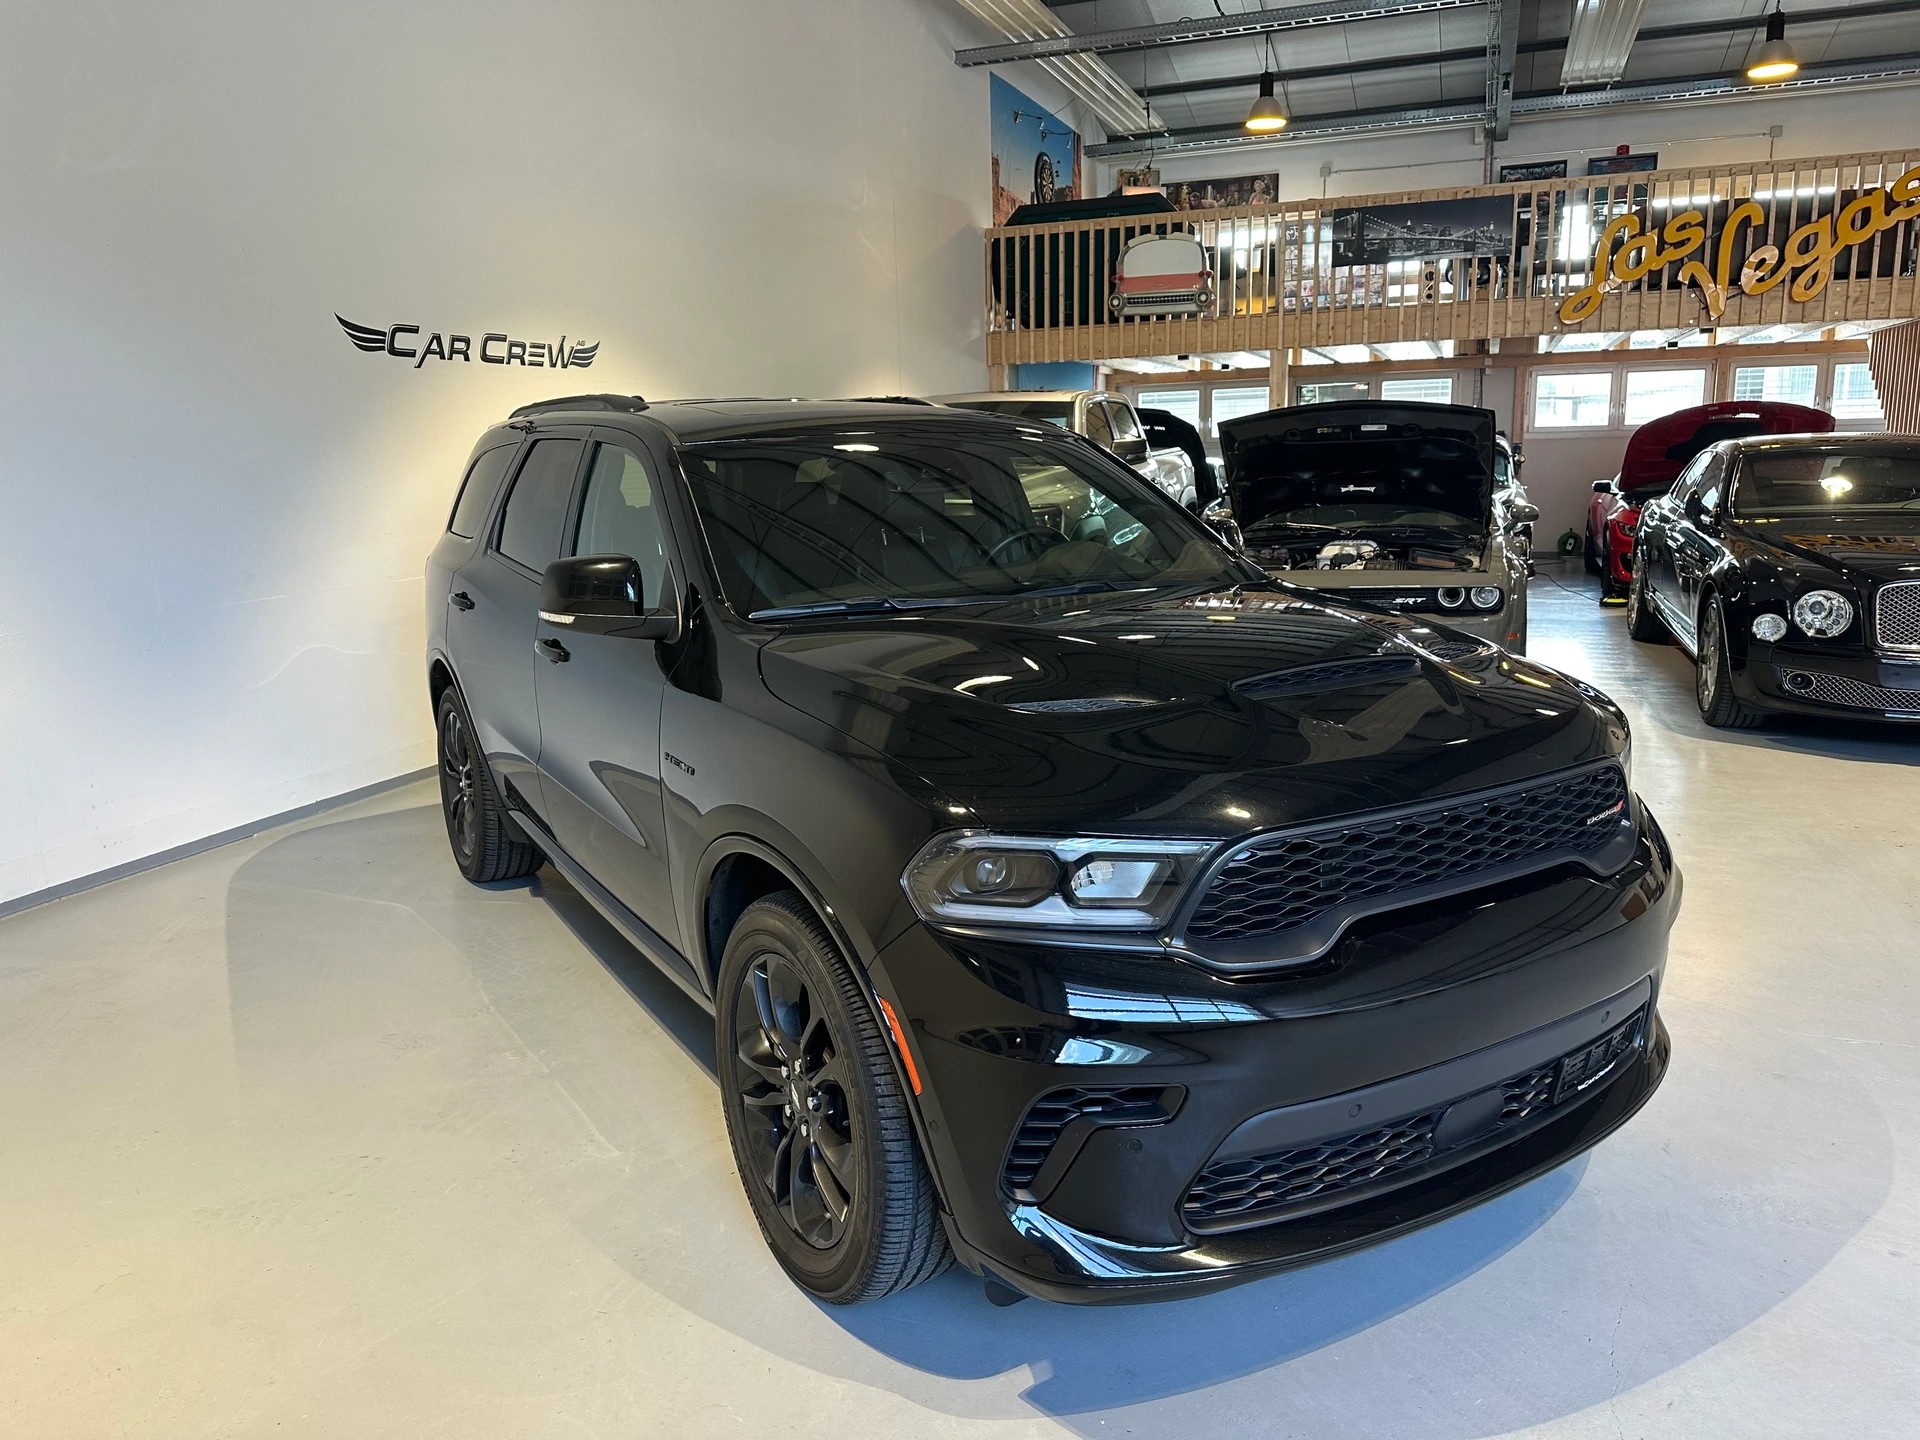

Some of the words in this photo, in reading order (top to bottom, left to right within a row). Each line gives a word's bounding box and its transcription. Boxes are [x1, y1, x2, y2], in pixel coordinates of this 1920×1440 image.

[1559, 209, 1706, 325] Las
[386, 323, 471, 369] CAR
[480, 332, 574, 369] CREW
